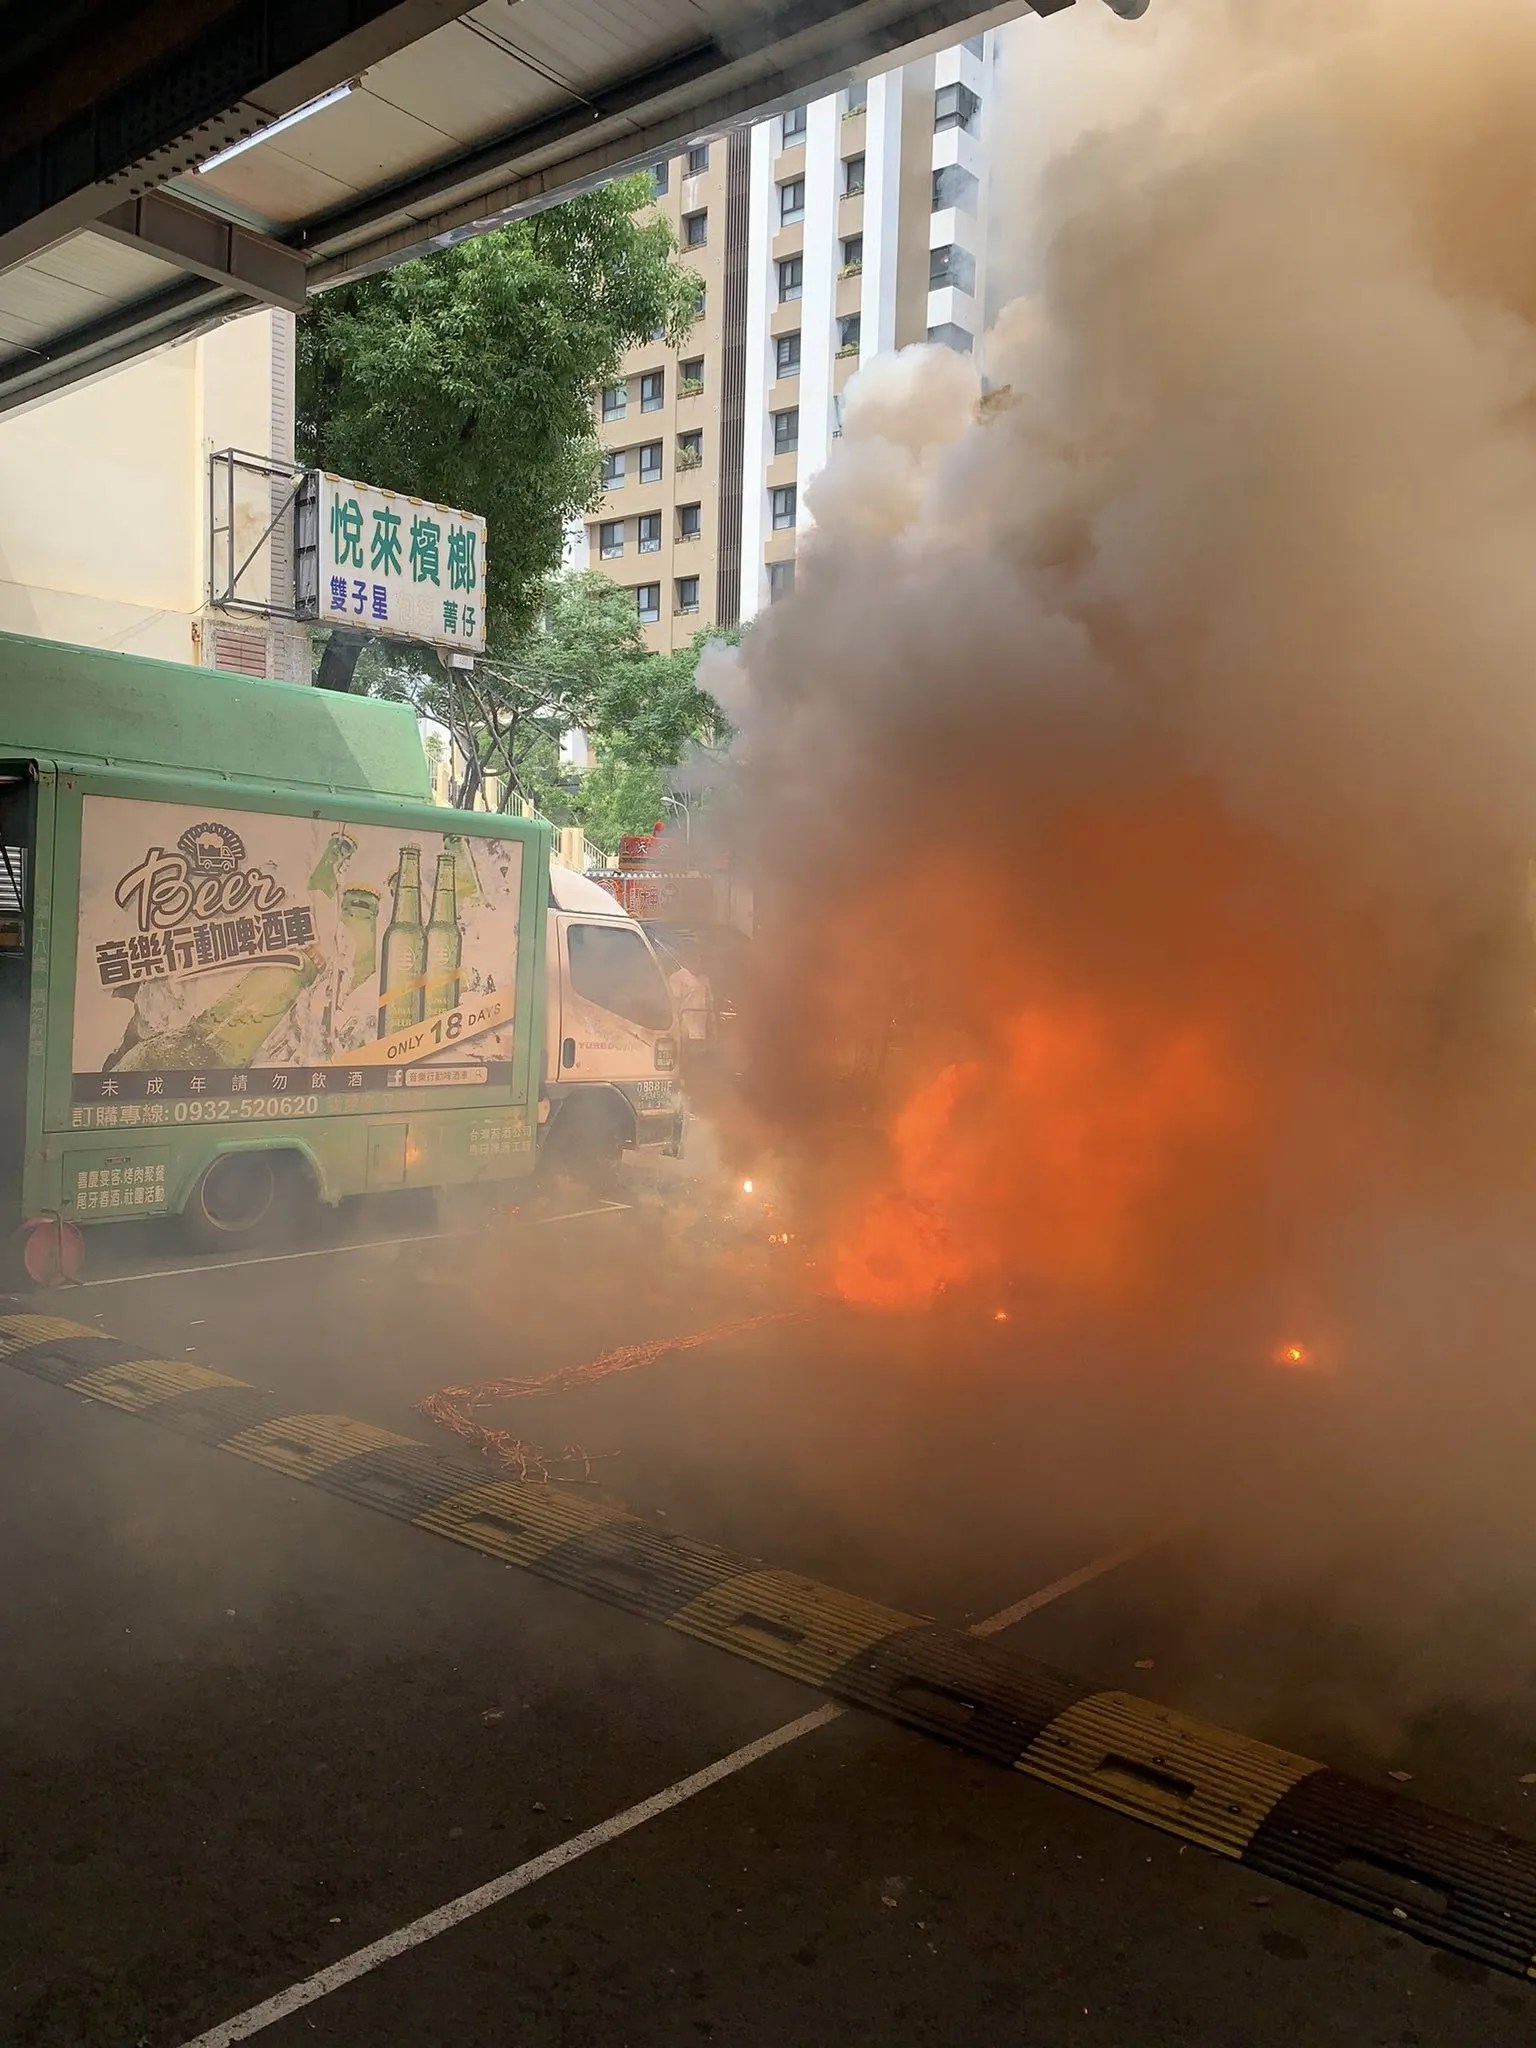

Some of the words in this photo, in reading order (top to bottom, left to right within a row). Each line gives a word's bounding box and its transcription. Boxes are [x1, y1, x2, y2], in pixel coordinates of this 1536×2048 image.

[330, 492, 477, 594] 悅來檳榔
[330, 575, 388, 621] 雙子星
[442, 600, 477, 638] 菁仔
[115, 846, 286, 932] Beer
[95, 906, 315, 985] 音樂行動啤酒車
[387, 1034, 424, 1060] ONLY
[430, 1012, 463, 1045] 18
[468, 1003, 501, 1026] DAYS
[72, 1103, 169, 1128] 訂購專線:
[174, 1096, 318, 1122] 0932-520620
[101, 1071, 363, 1096] 未成年請勿飲酒
